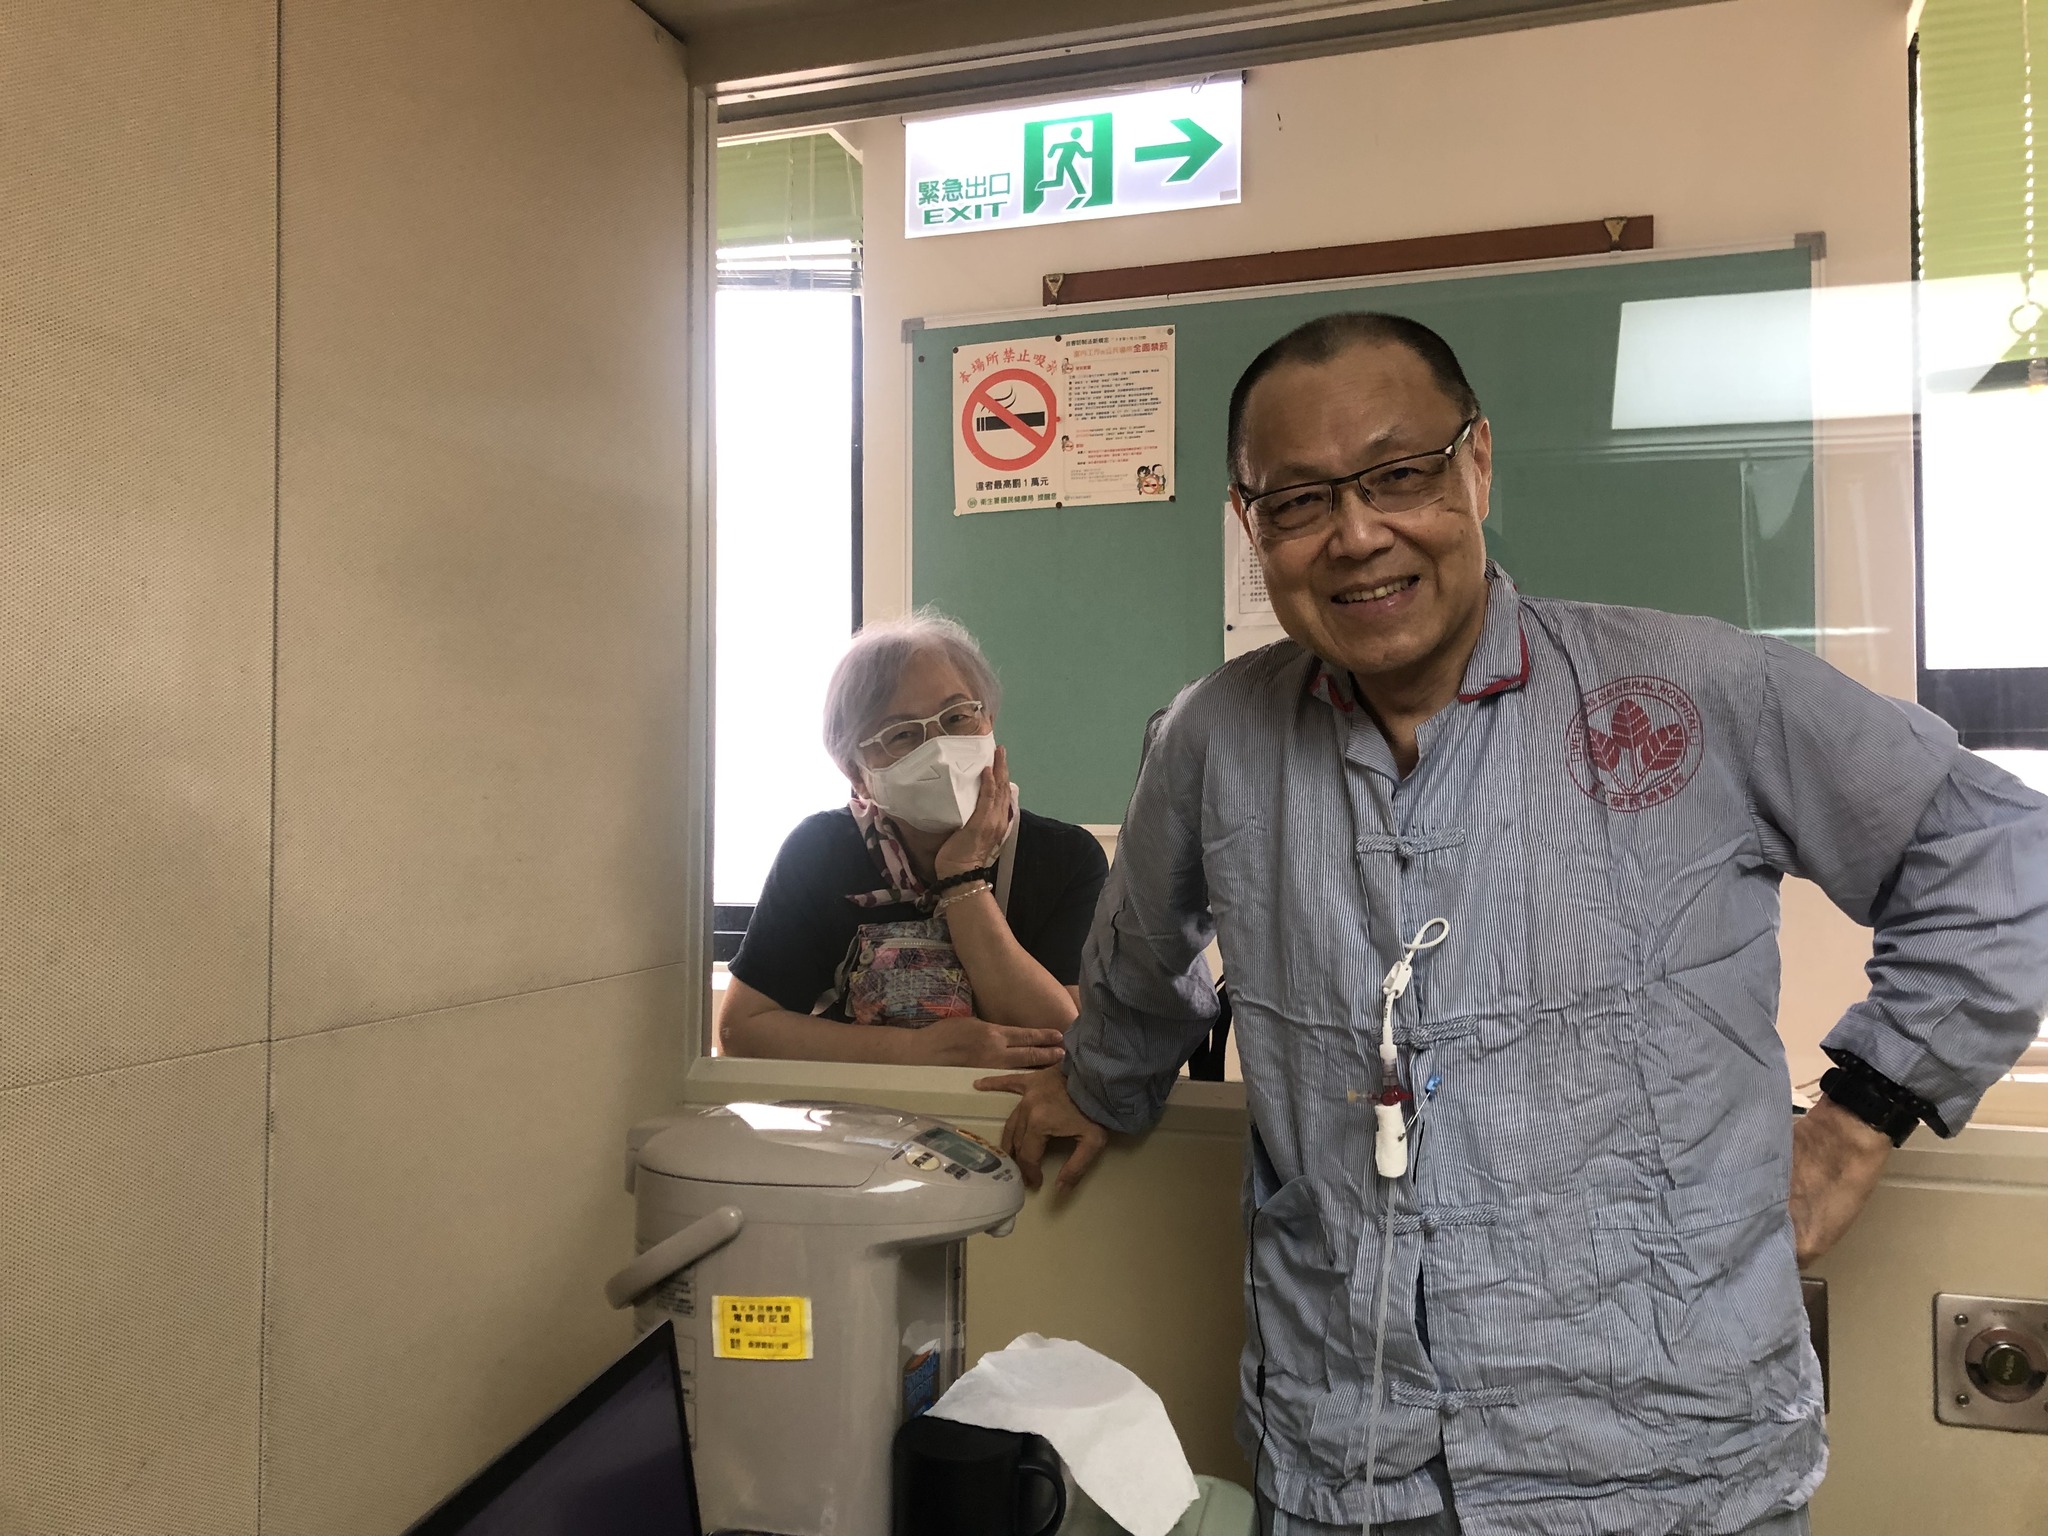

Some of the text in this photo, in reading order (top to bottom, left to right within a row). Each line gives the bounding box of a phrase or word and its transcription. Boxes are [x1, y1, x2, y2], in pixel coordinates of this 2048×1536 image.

[918, 172, 1011, 206] 緊急出口
[923, 201, 1008, 225] EXIT
[1598, 681, 1655, 700] GENERAL
[1659, 684, 1698, 733] HOSPITAL
